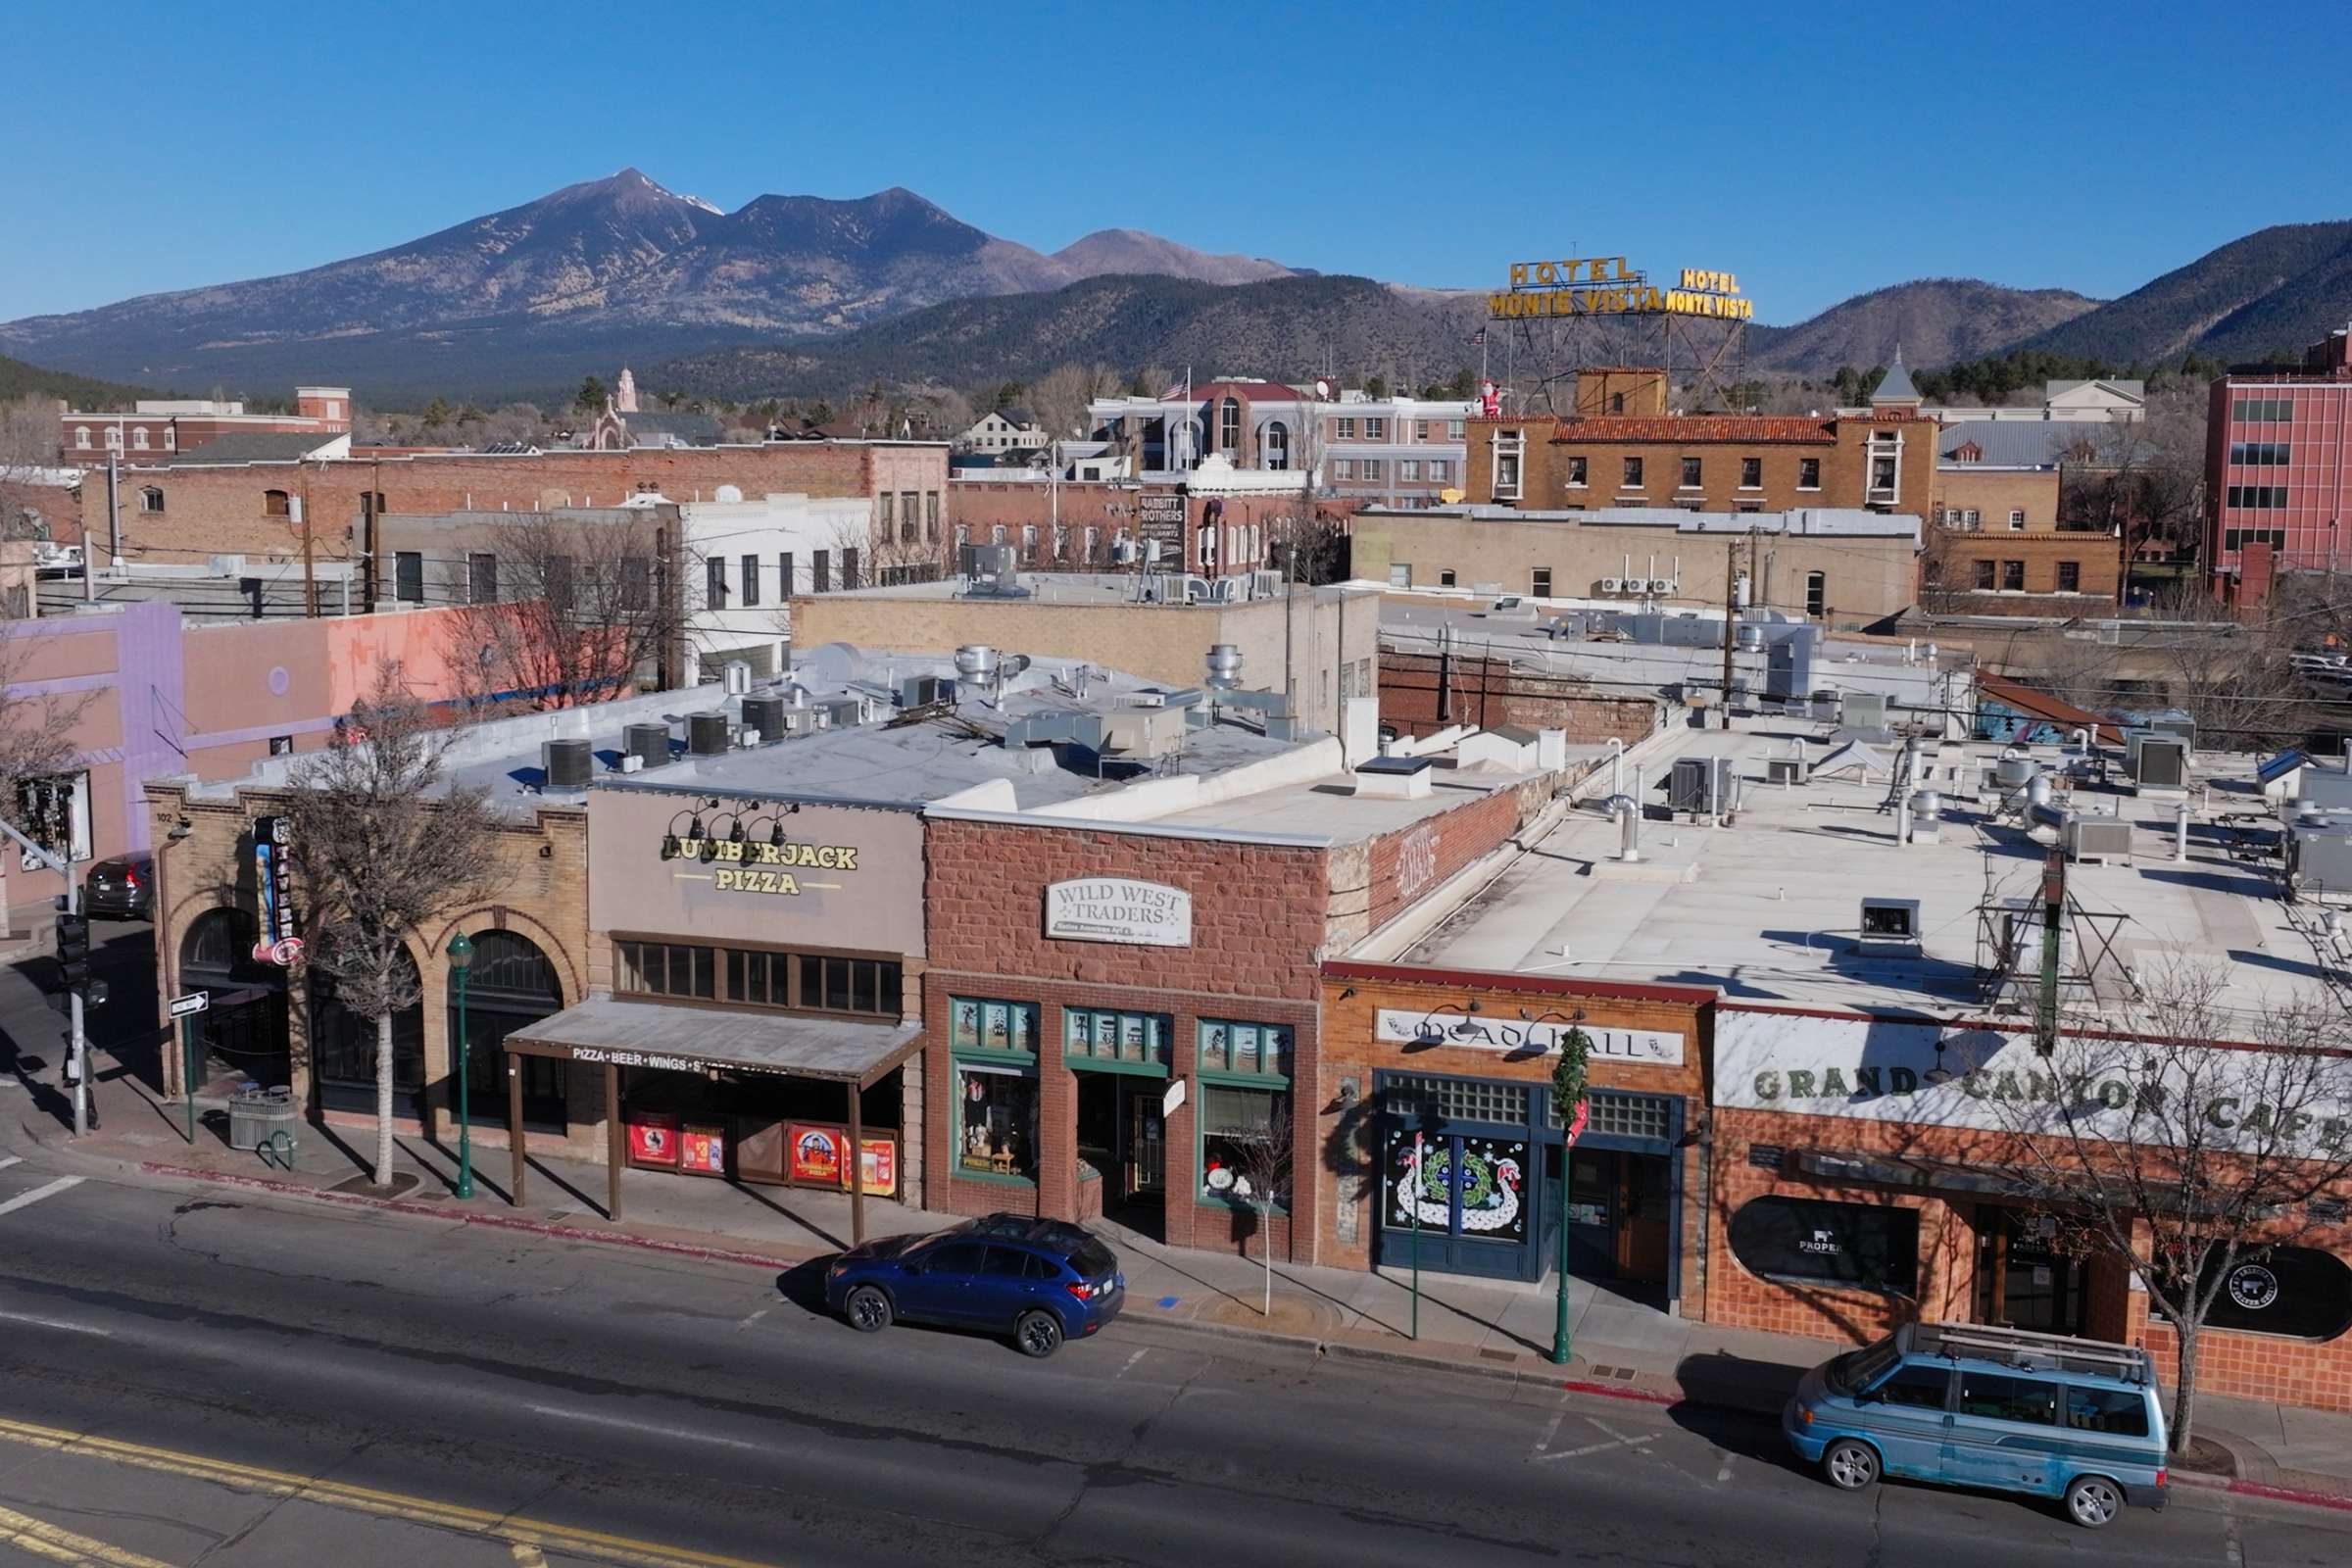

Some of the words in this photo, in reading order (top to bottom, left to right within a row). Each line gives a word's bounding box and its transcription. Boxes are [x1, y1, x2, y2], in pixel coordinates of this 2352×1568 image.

[1510, 257, 1635, 284] HOTEL
[1682, 269, 1740, 294] HOTEL
[1489, 290, 1574, 317] MONTE
[1584, 286, 1663, 314] VISTA
[1666, 291, 1711, 315] MONTE
[1715, 297, 1753, 318] VISTA
[1138, 511, 1183, 522] ROTHERS
[157, 813, 172, 823] 102
[662, 836, 858, 870] LUMBERJACK
[716, 868, 800, 895] PIZZA
[1057, 884, 1114, 905] WILD
[1121, 885, 1182, 911] WEST
[1073, 904, 1164, 924] TRADERS
[1414, 1022, 1521, 1047] MEAD
[573, 1049, 605, 1061] PIZZA
[611, 1052, 643, 1066] BEER
[649, 1056, 686, 1070] WINGS
[1753, 1066, 1918, 1100] GRAND
[1961, 1066, 2166, 1114] CANYO
[2206, 1098, 2347, 1150] CAFE
